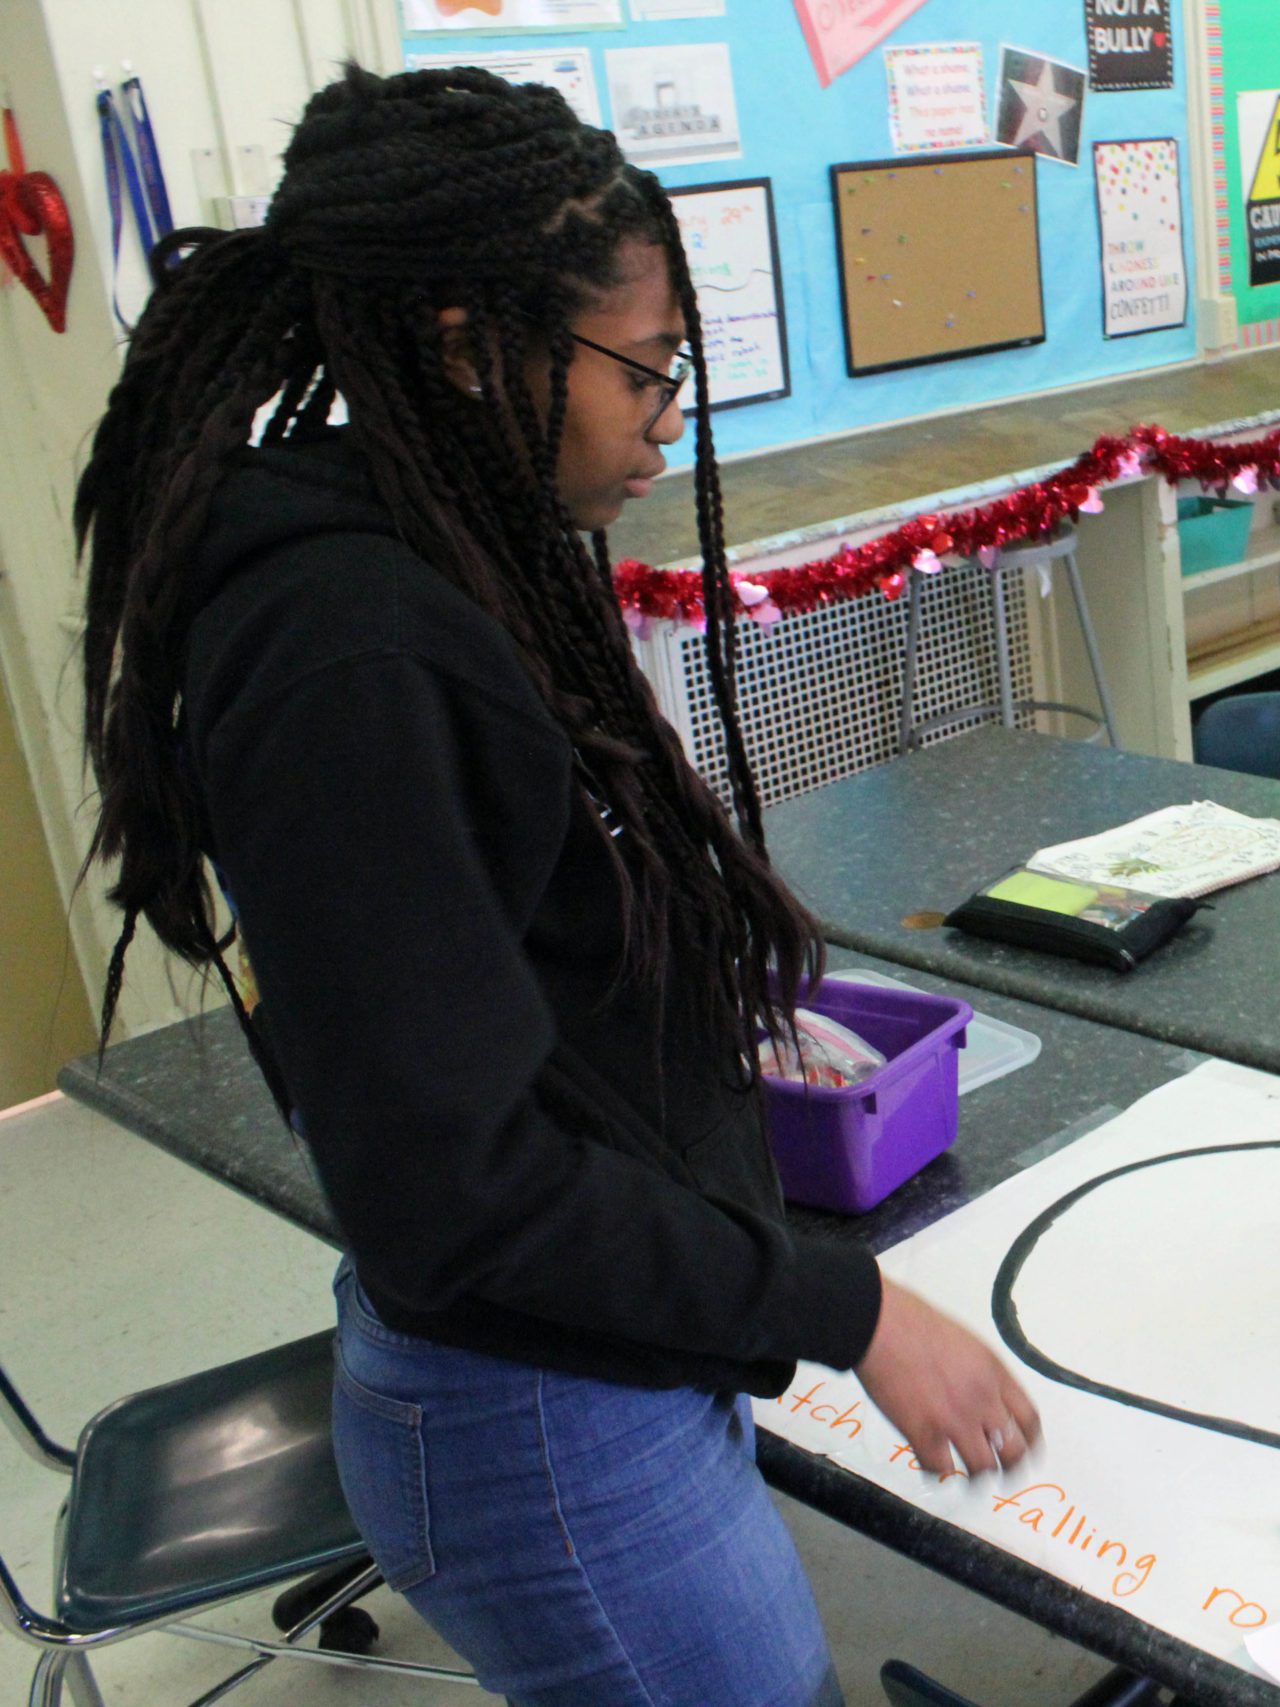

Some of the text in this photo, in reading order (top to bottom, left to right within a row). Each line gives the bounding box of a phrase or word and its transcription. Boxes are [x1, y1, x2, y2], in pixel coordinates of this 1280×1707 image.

[1143, 0, 1161, 15] A
[1094, 26, 1153, 54] BULLY
[640, 118, 720, 136] AGENDA
[1107, 240, 1145, 256] THROW
[1255, 251, 1267, 262] IN
[1111, 276, 1156, 293] AROUND
[1110, 293, 1169, 320] CONFETTI
[776, 1381, 862, 1439] tch
[993, 1484, 1157, 1597] falling
